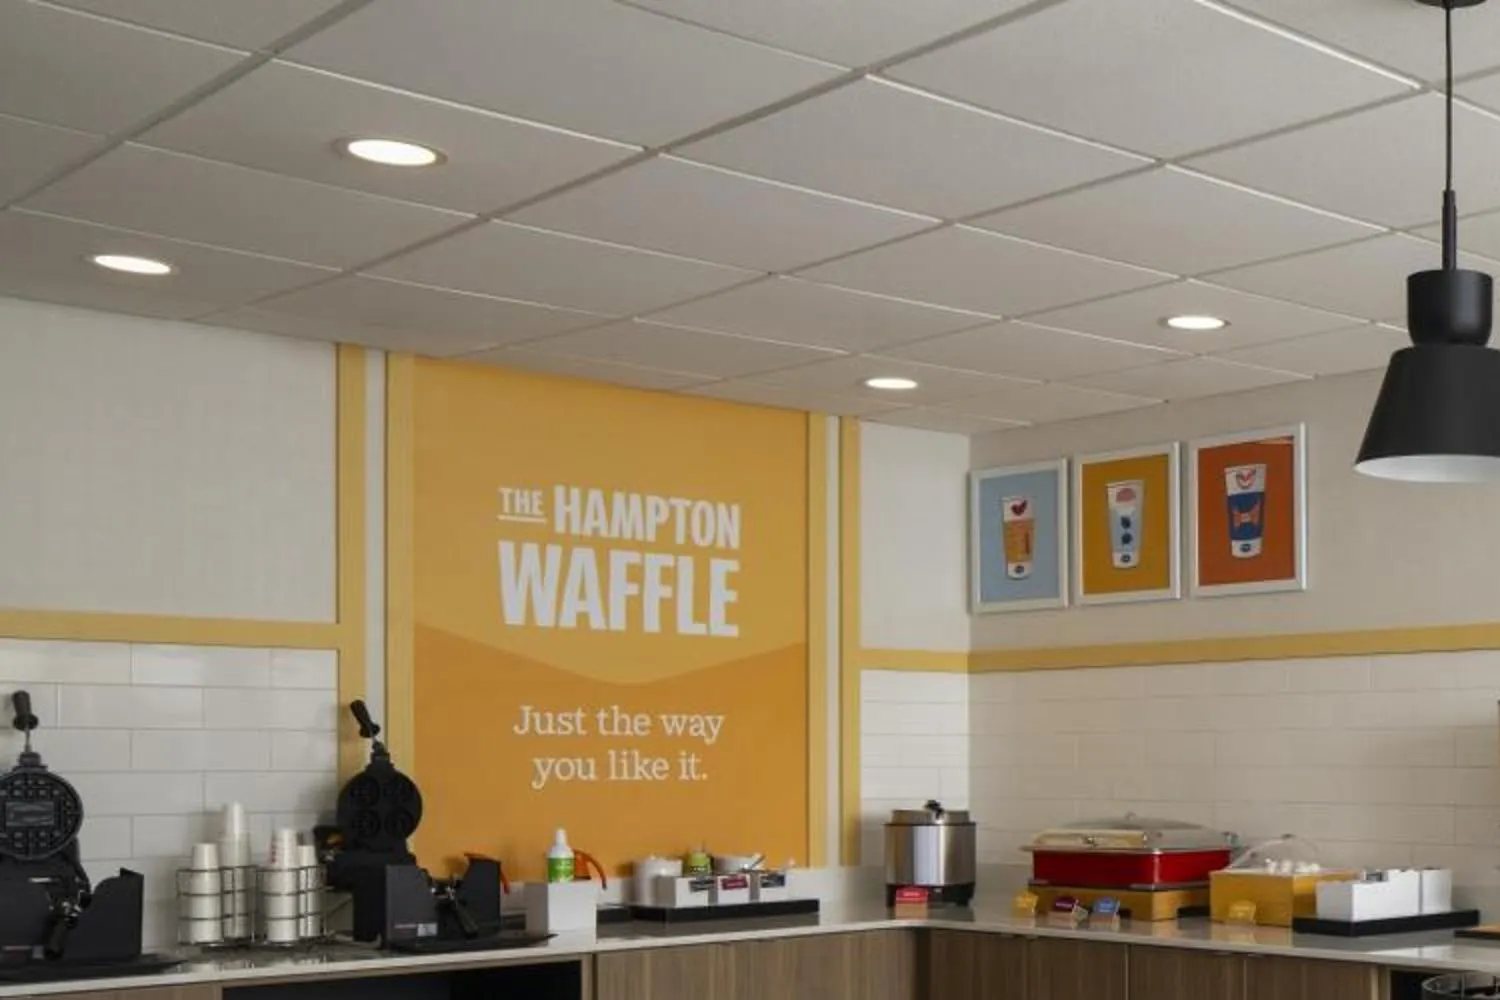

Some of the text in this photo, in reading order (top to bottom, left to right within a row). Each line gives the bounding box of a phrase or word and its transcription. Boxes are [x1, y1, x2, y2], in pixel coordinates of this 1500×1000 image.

[499, 485, 741, 550] THE HAMPTON
[498, 540, 740, 637] WAFFLE
[513, 706, 724, 744] Just the way
[532, 751, 708, 788] you like it.
